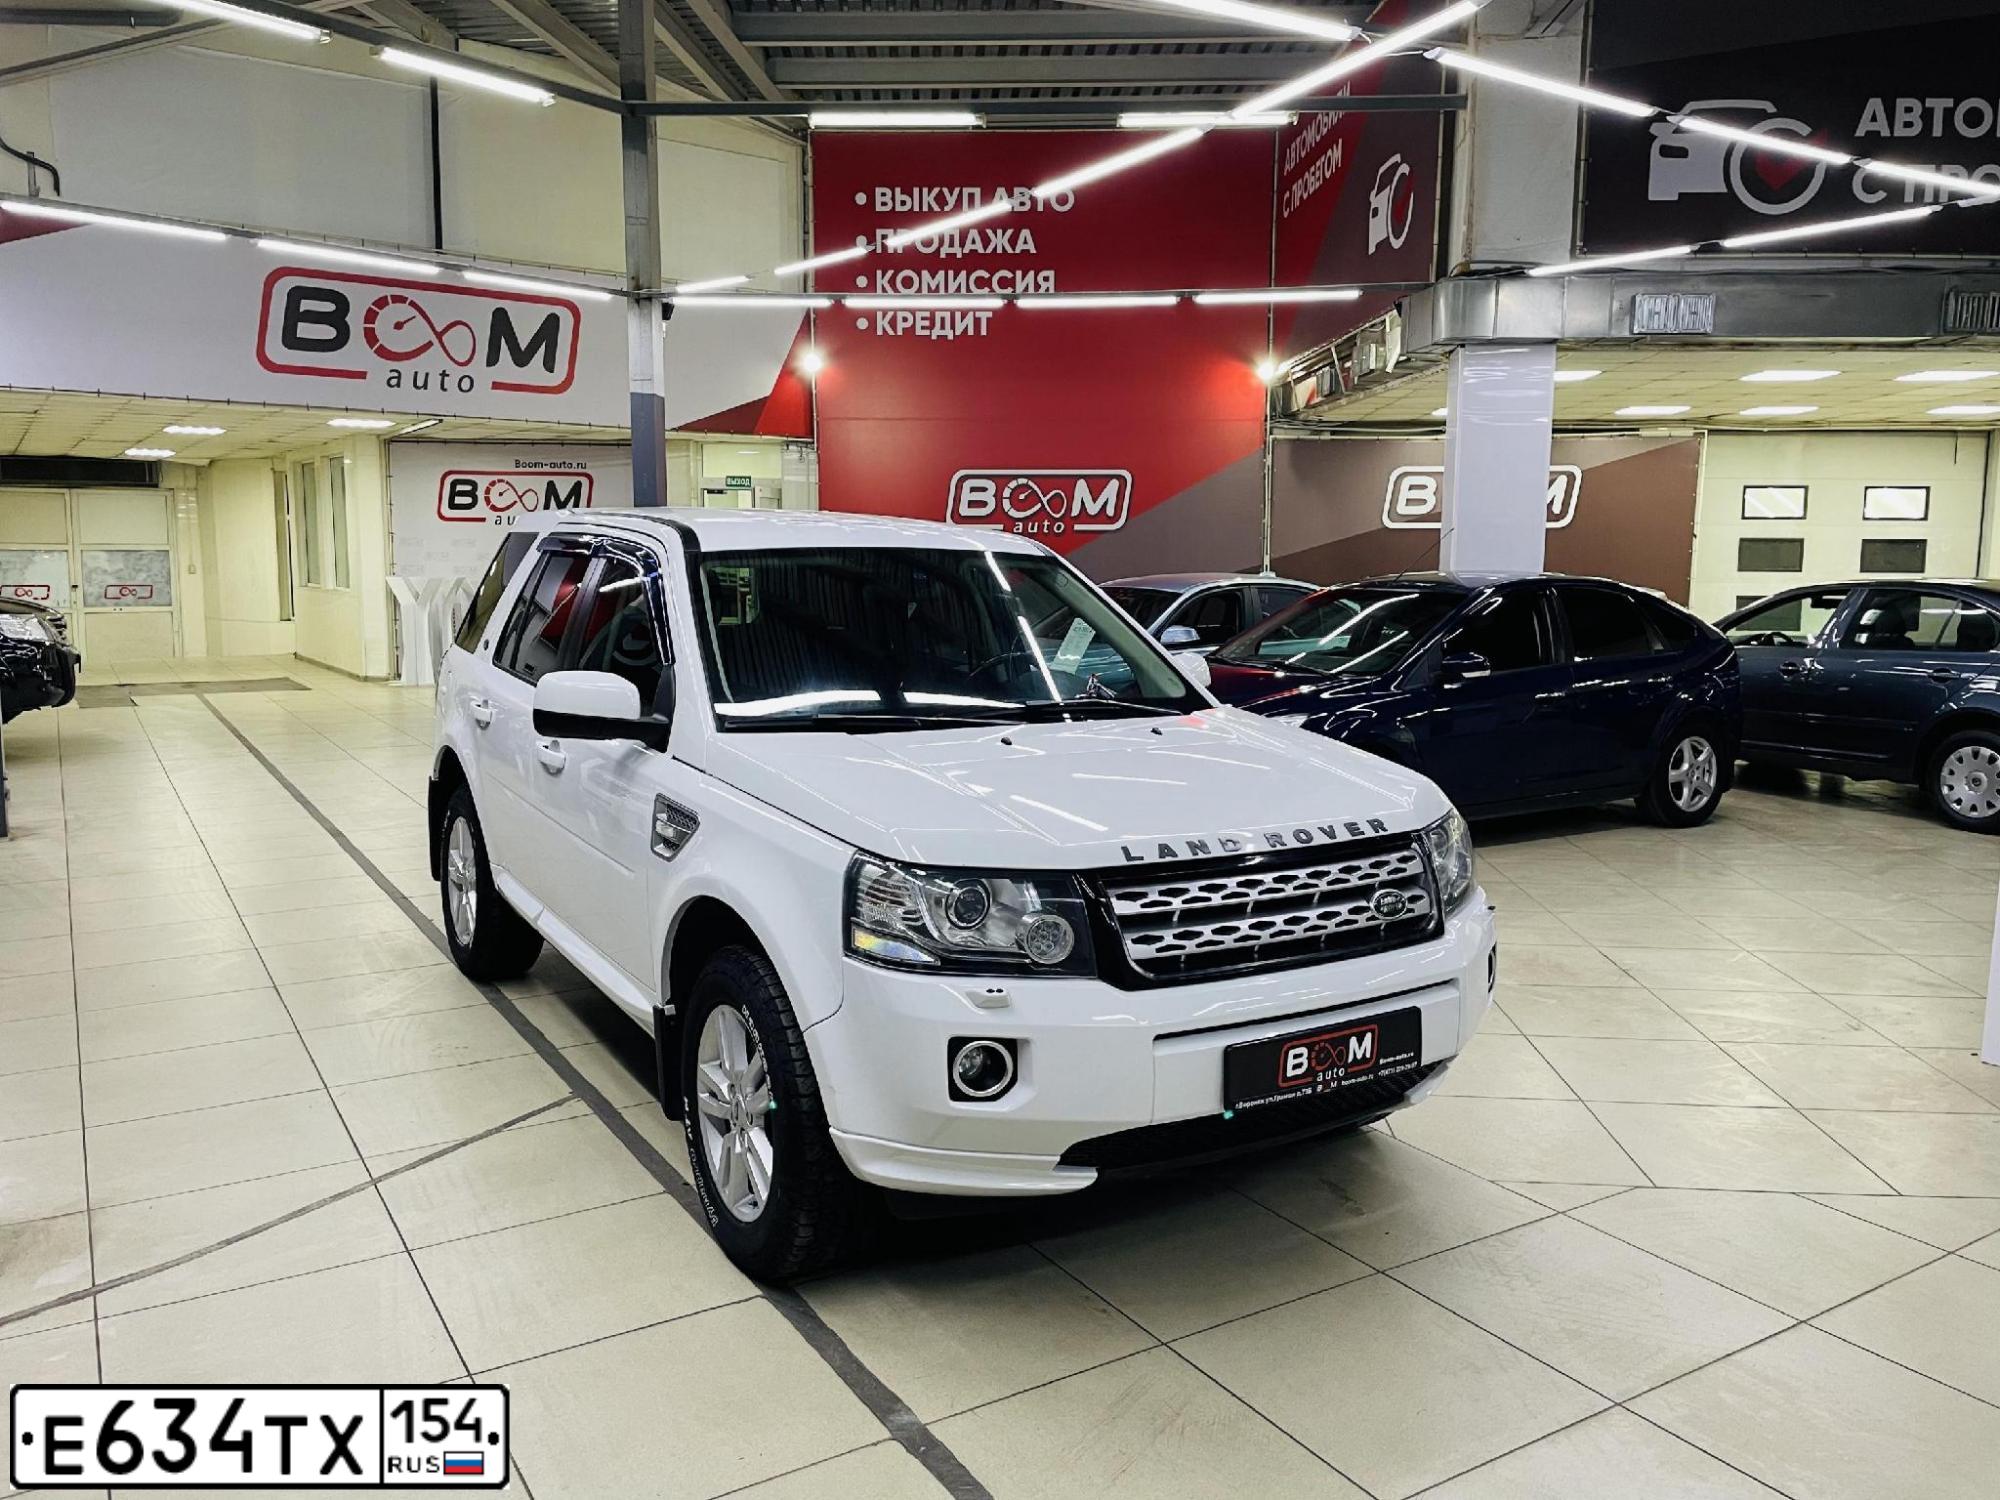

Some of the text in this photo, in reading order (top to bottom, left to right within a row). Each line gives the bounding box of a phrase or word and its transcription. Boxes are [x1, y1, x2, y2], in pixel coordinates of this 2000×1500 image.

[1854, 97, 2000, 138] АВТО
[1291, 138, 1342, 212] ПРОБЕГОМ
[875, 187, 1075, 213] ВЫКУП АВТО
[876, 229, 1036, 258] ПРОДАЖА
[876, 269, 1055, 294] КОМИССИЯ
[876, 311, 993, 340] КРЕДИТ
[386, 368, 475, 393] auto
[514, 459, 587, 470] Boom-auto.ru
[1013, 519, 1065, 533] auto
[1121, 817, 1389, 862] LAND ROVER
[1316, 1067, 1345, 1082] auto
